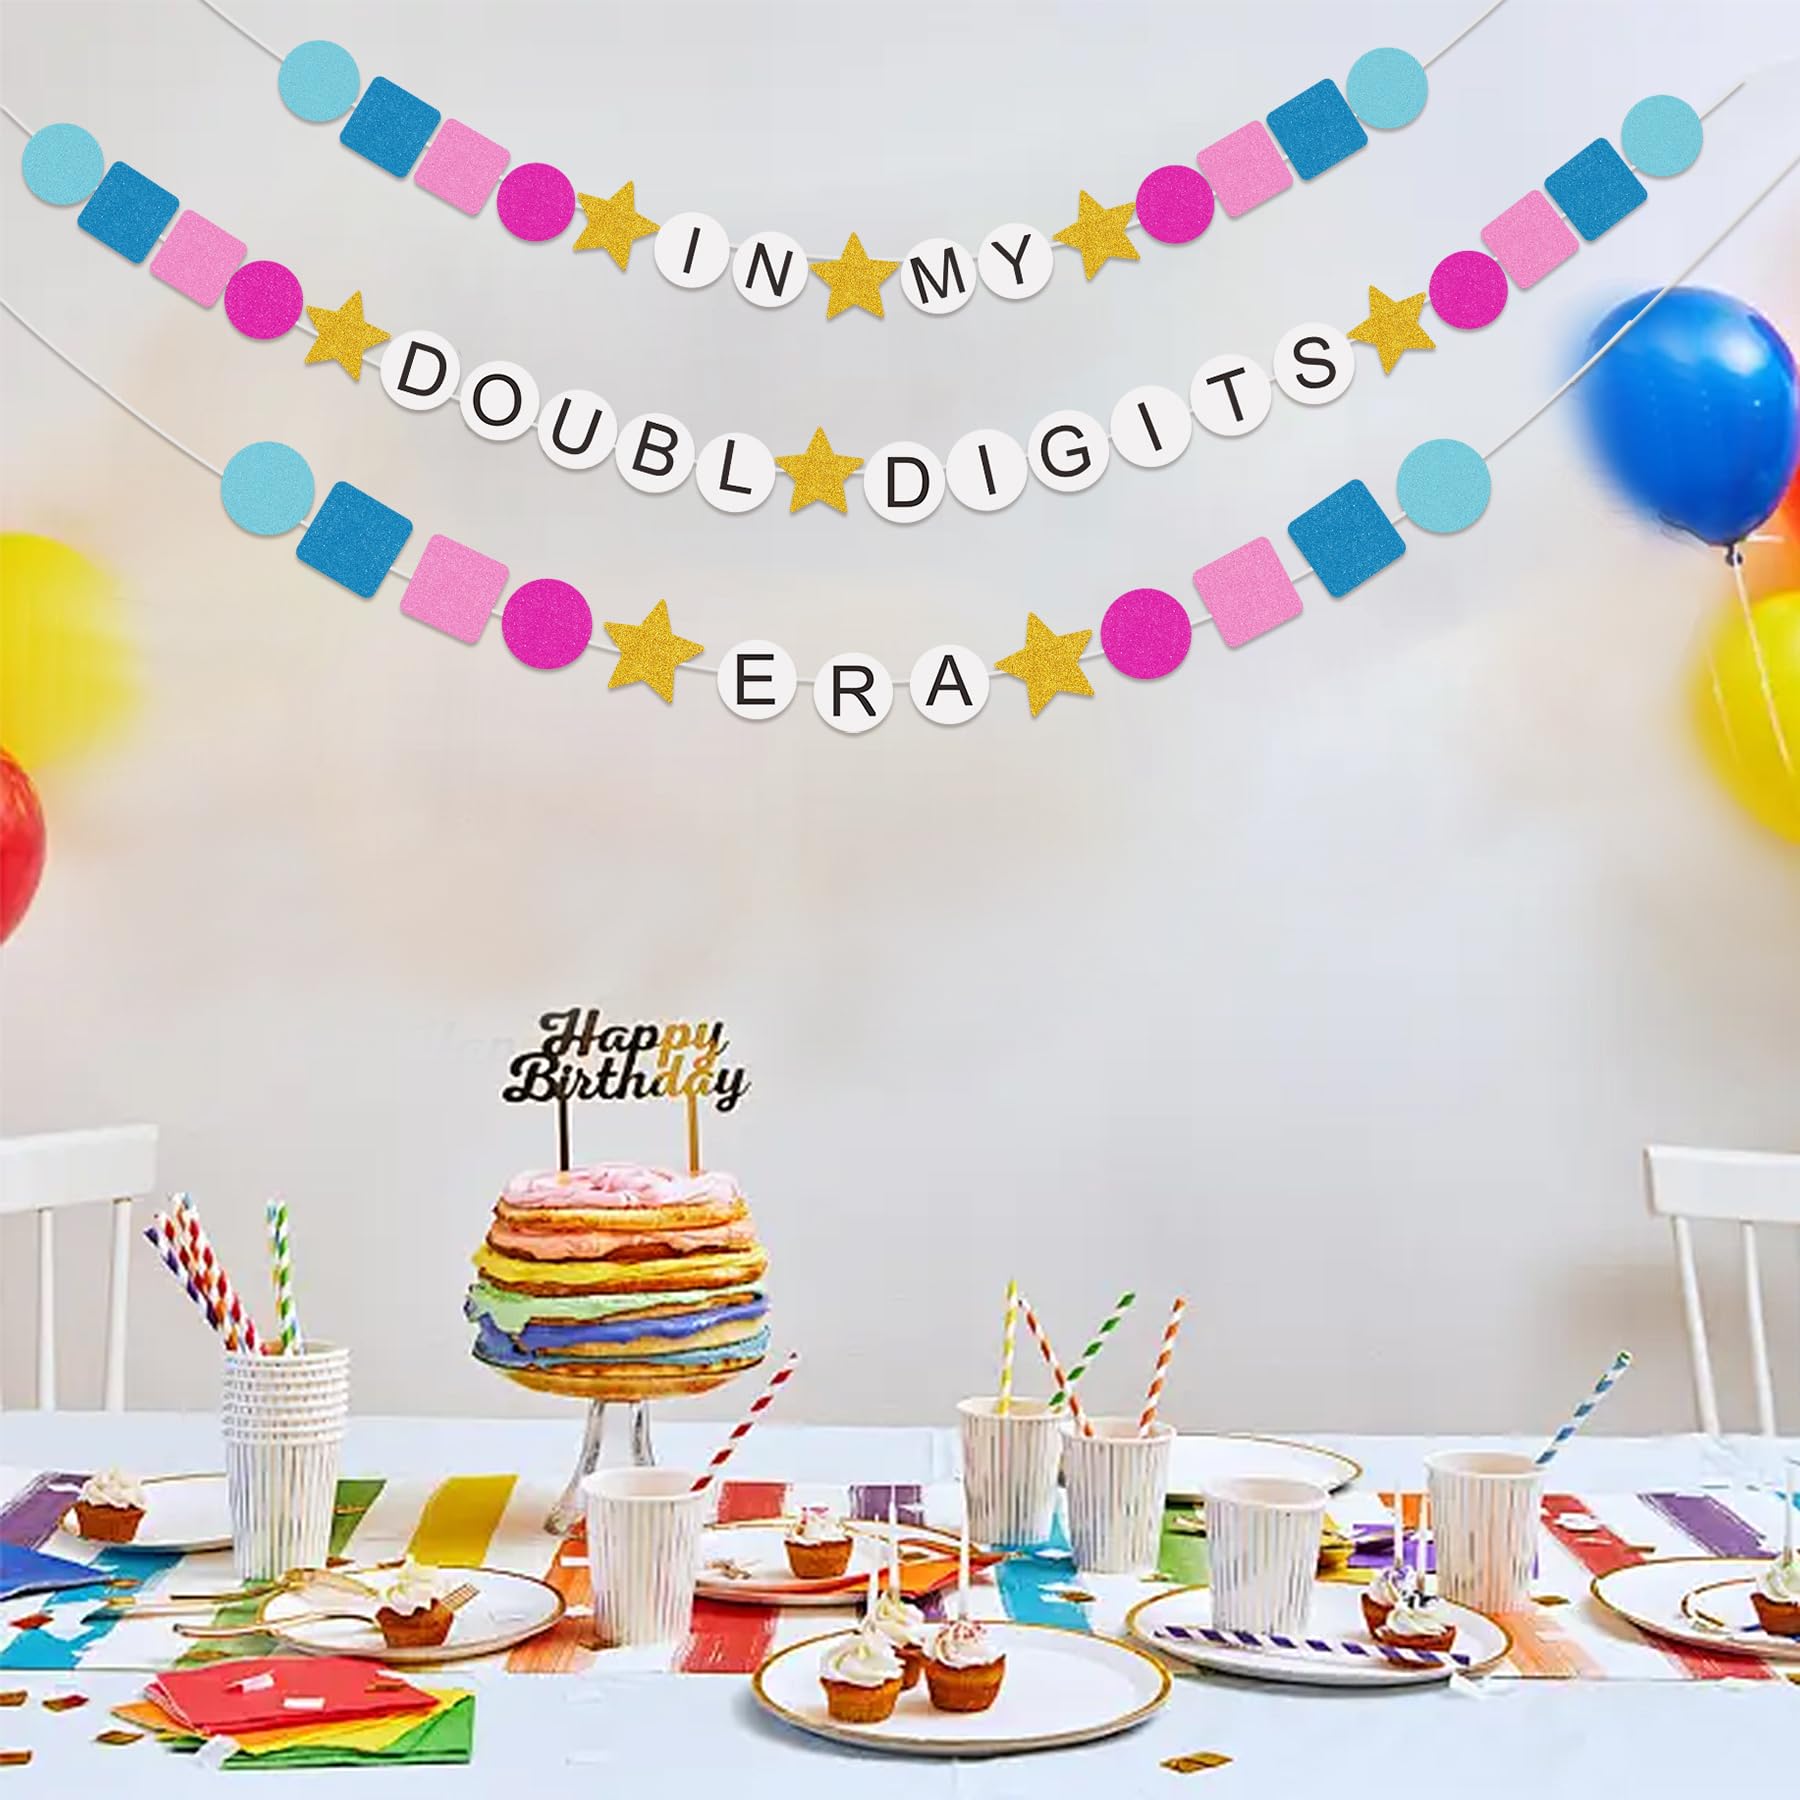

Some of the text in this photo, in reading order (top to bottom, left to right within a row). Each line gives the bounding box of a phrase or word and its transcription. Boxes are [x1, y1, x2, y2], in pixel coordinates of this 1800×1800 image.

[683, 228, 1031, 304] IN MY
[397, 336, 1337, 508] DOUBL DIGITS
[736, 653, 973, 717] ERA
[539, 1007, 729, 1070] Happy
[502, 1053, 750, 1112] Birthday
